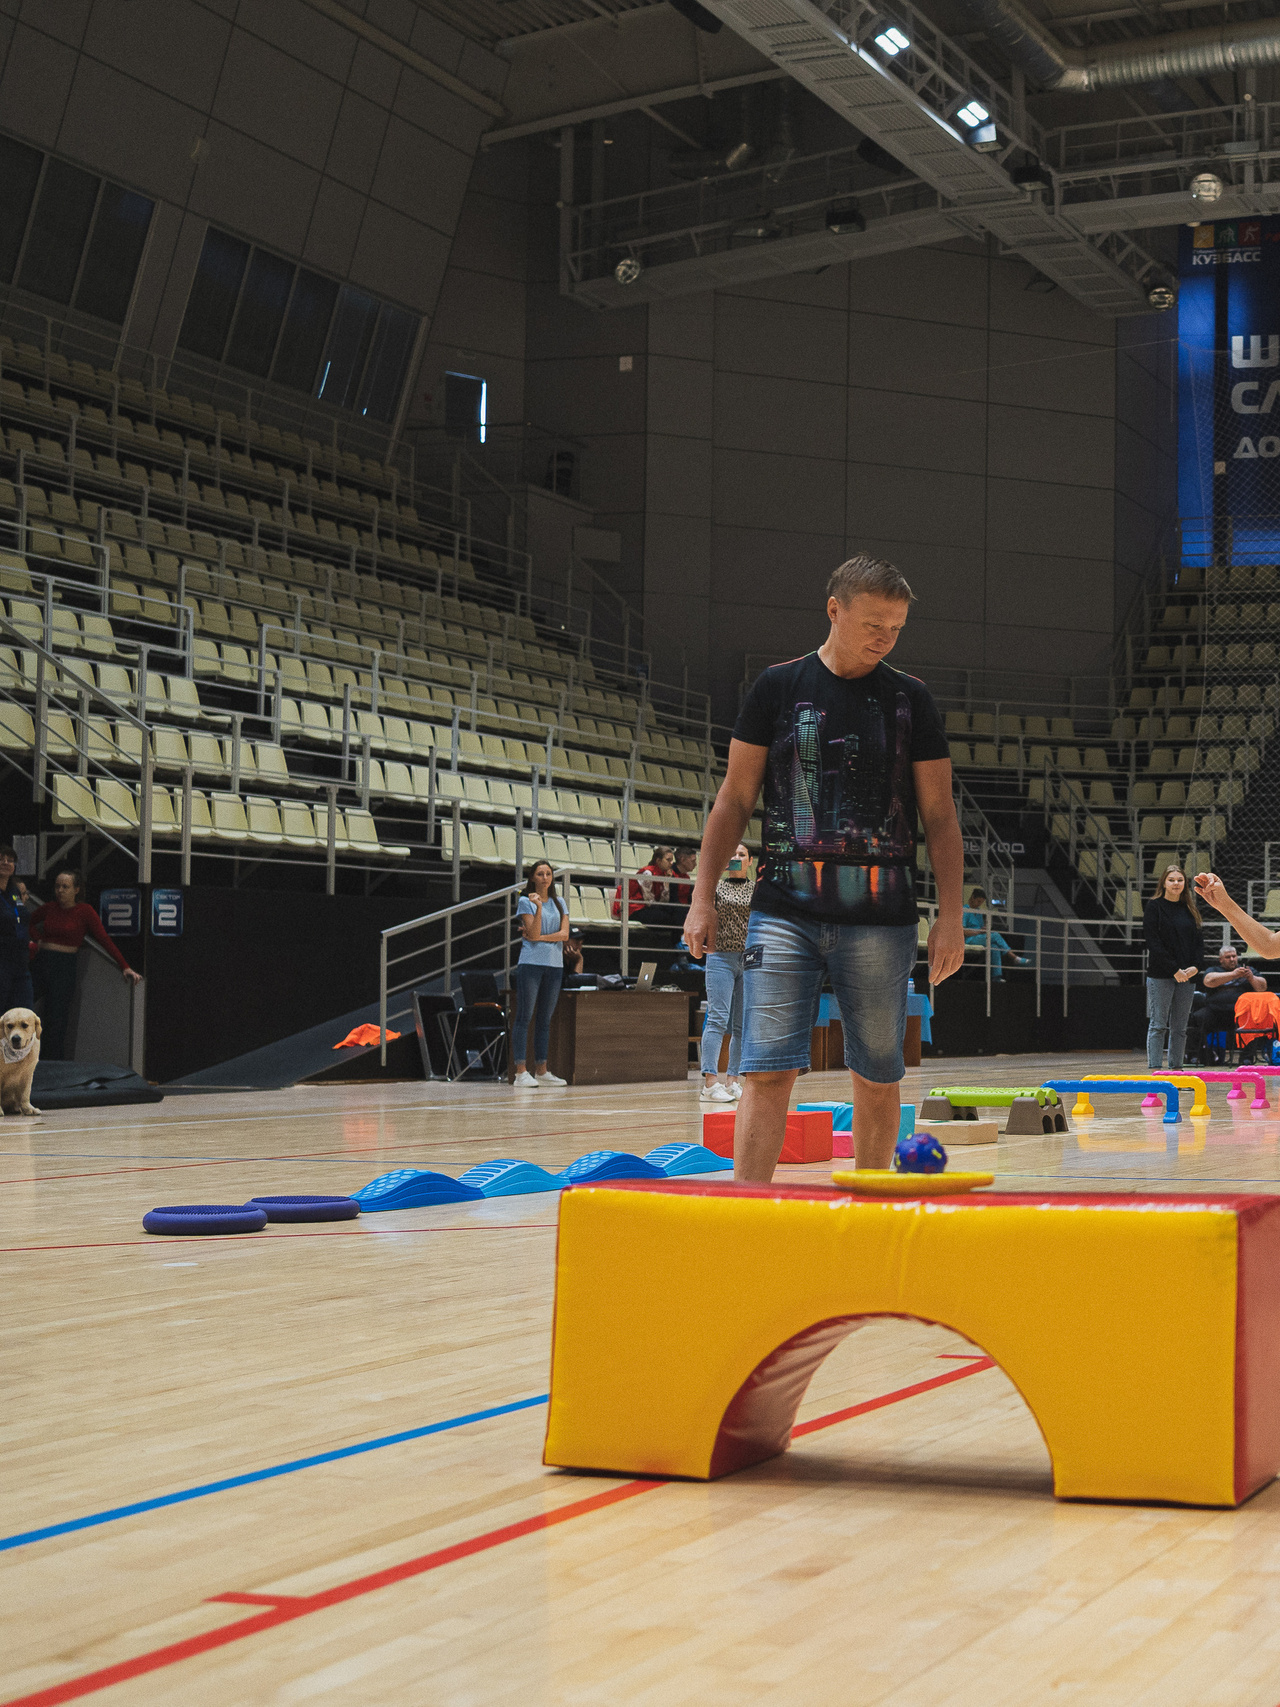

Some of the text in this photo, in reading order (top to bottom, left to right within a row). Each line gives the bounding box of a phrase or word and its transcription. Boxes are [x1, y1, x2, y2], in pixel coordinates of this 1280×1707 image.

[1192, 251, 1261, 266] КУЗБАСС
[108, 903, 133, 926] 2
[158, 903, 177, 926] 2
